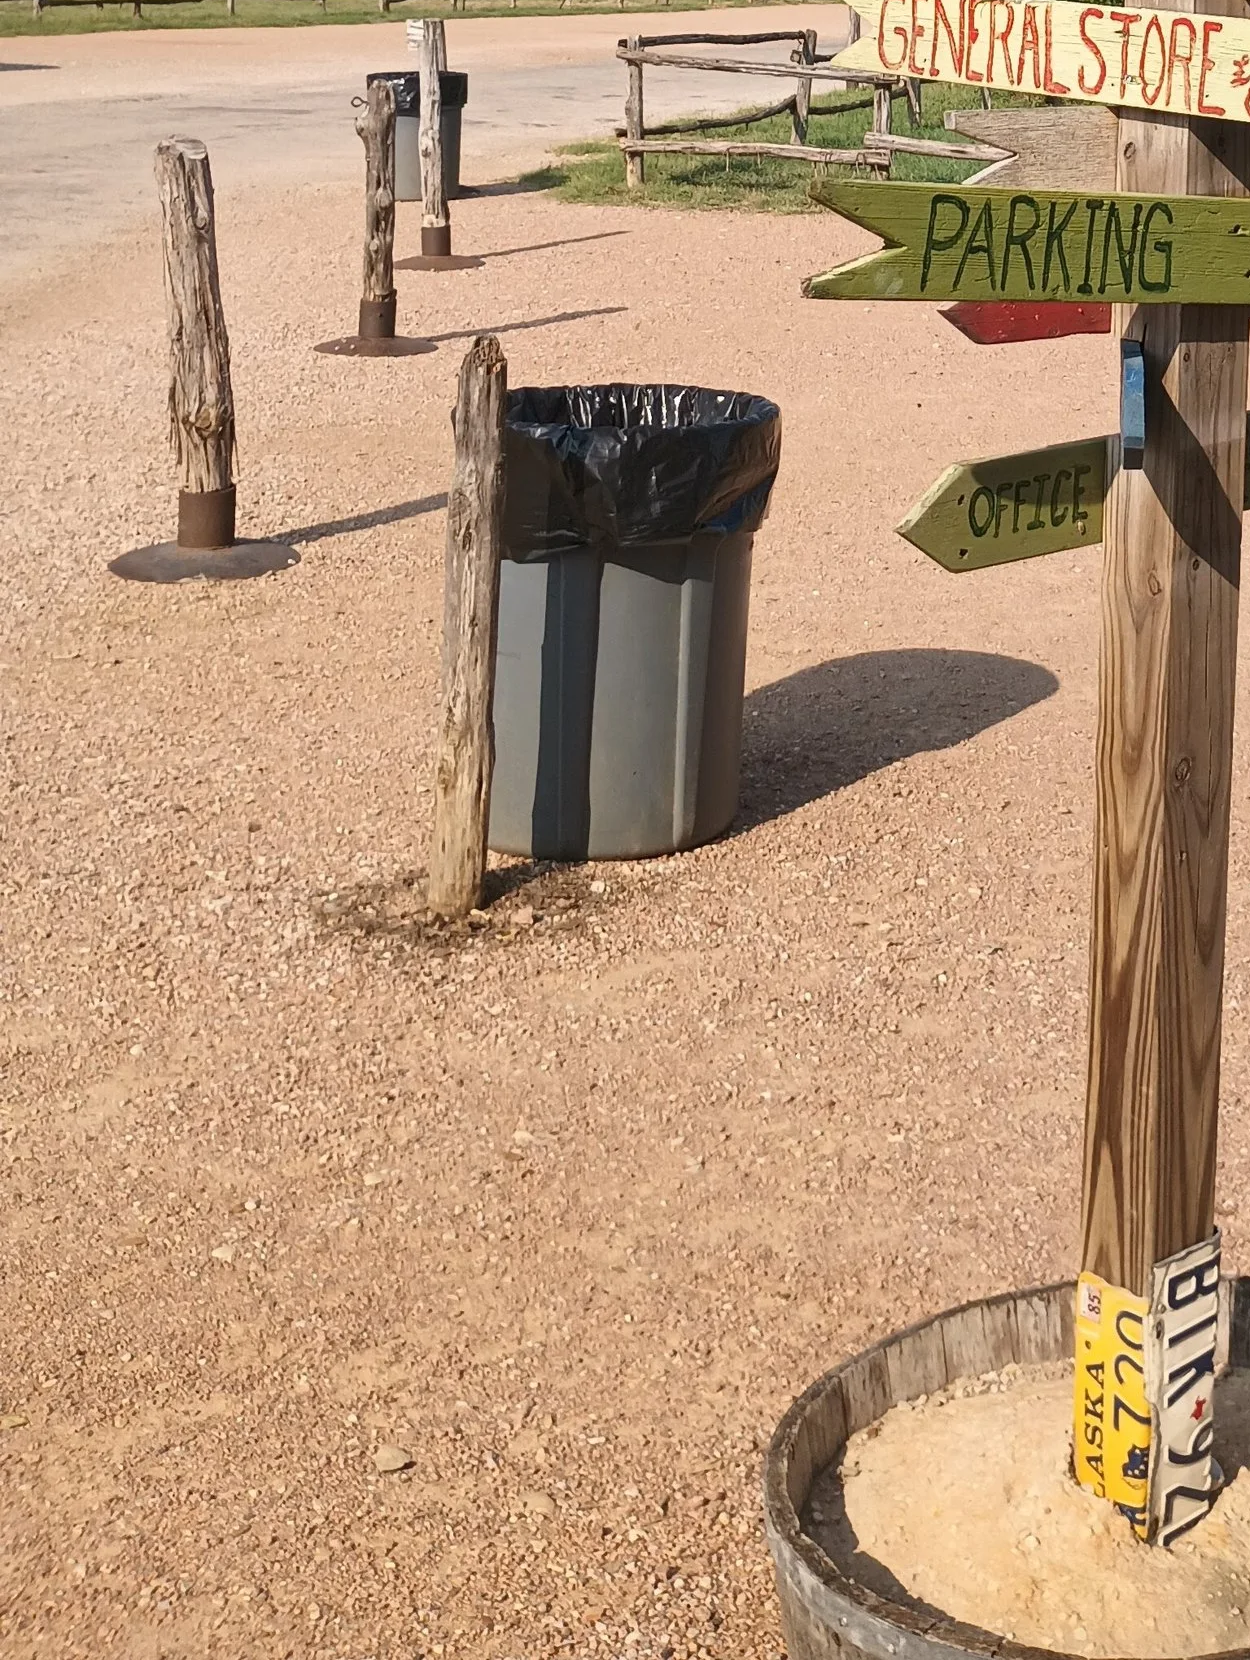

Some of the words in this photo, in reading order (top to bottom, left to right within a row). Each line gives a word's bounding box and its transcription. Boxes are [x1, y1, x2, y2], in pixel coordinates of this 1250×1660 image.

[1077, 7, 1226, 118] STORE
[919, 193, 1174, 295] PARKING
[968, 463, 1092, 539] OFFICE
[1087, 1292, 1101, 1315] 85
[1113, 1309, 1151, 1432] 720
